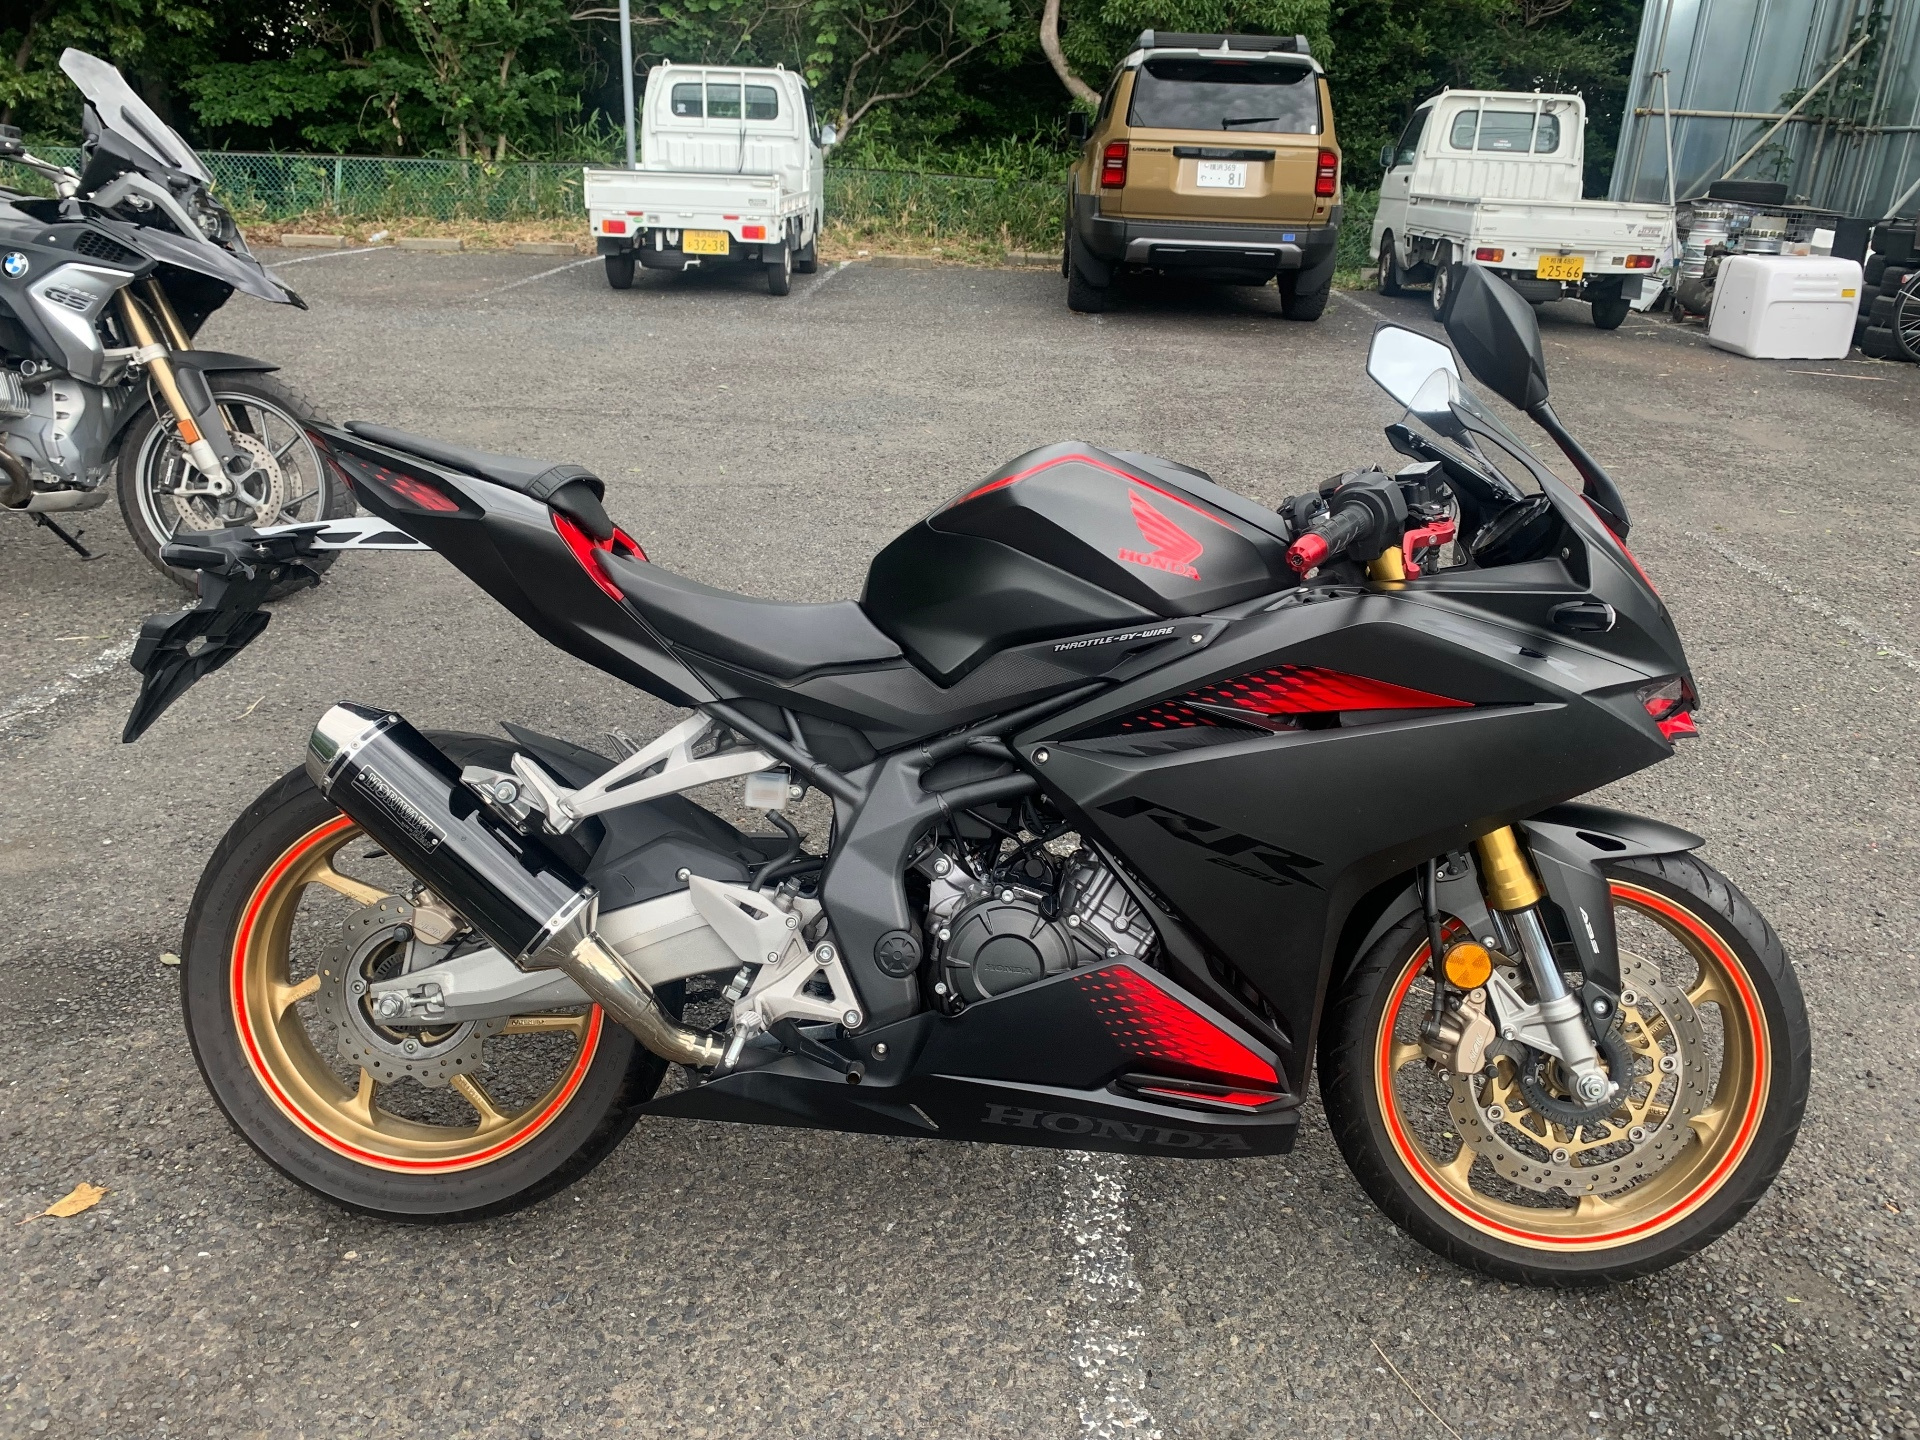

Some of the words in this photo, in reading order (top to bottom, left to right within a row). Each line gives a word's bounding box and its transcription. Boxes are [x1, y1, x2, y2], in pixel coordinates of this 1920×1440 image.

[693, 239, 725, 252] 32-38
[1547, 265, 1580, 278] 25-66
[1117, 547, 1201, 581] HONDA
[1053, 625, 1176, 652] THROTTLE-BY-WIRE
[363, 772, 434, 836] MORIWAKI
[1204, 857, 1294, 887] 250
[1578, 906, 1600, 954] ABS
[984, 963, 1033, 976] HONDA
[980, 1102, 1251, 1151] HONDA
